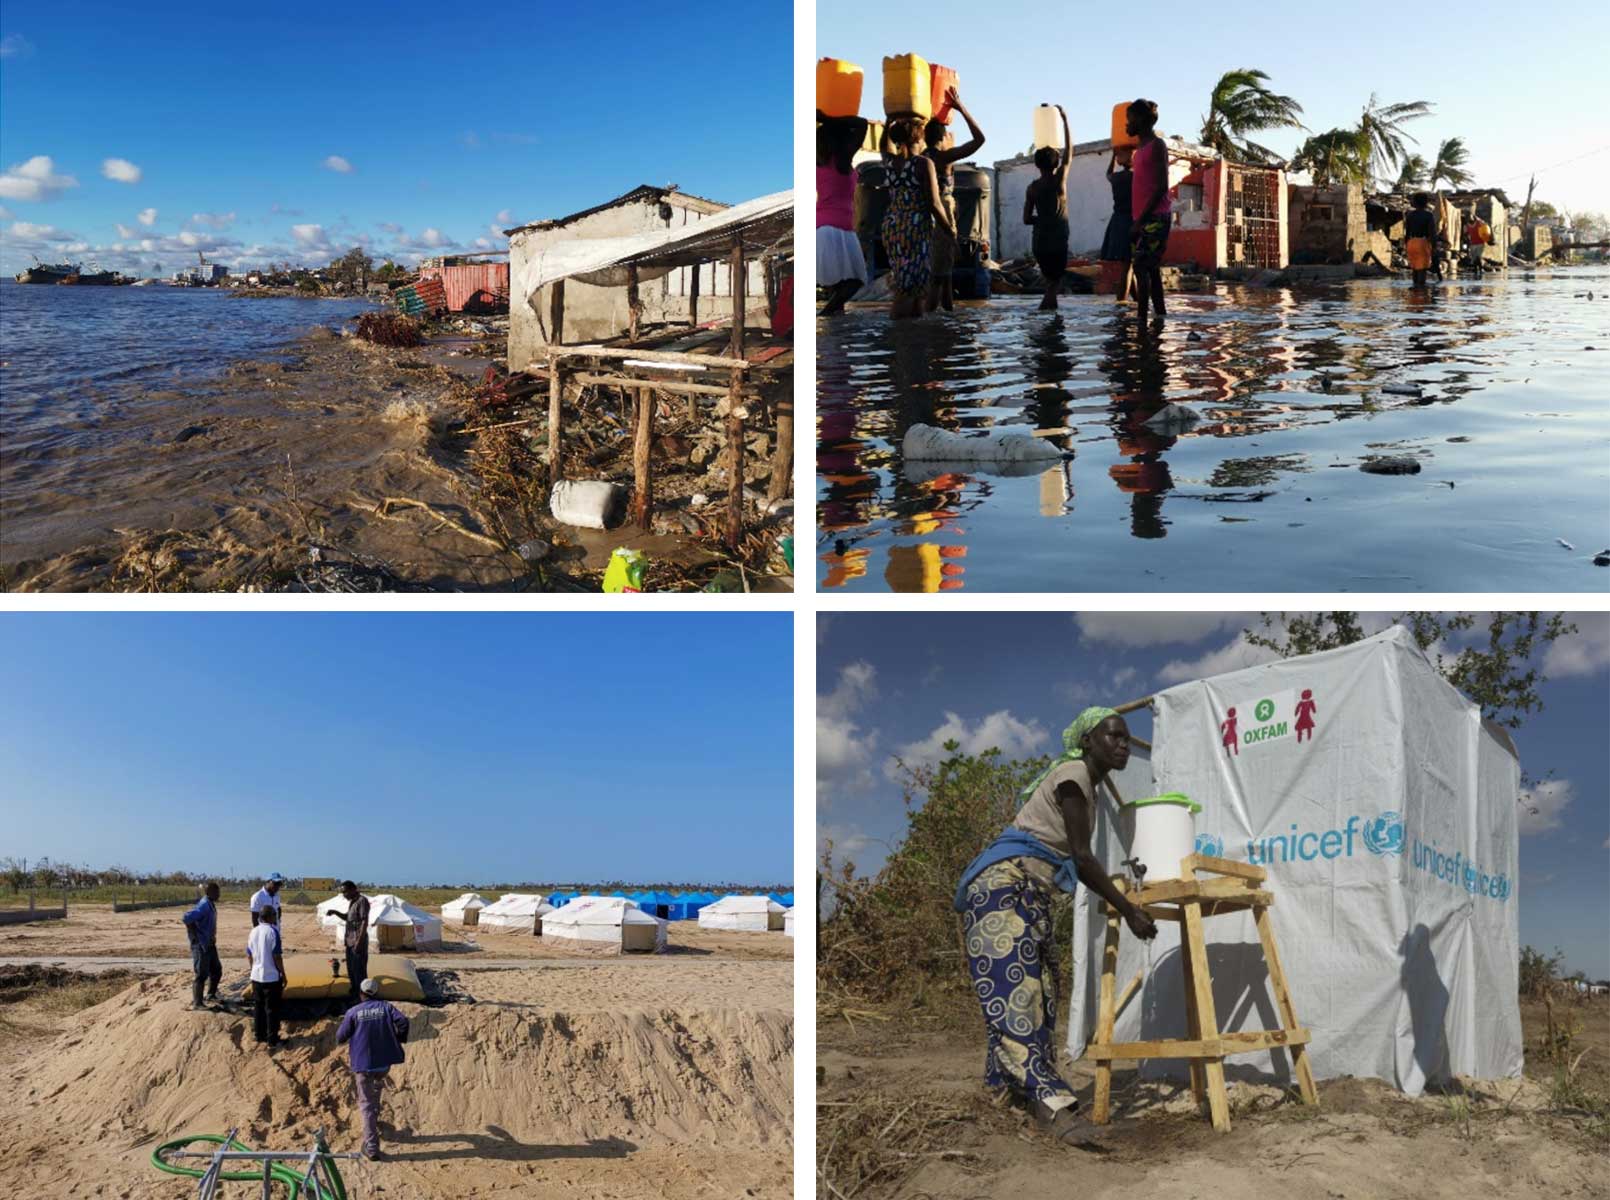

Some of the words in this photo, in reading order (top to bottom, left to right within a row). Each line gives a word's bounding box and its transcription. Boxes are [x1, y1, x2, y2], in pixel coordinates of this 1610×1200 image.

[1243, 721, 1288, 745] OXFAM
[1247, 815, 1360, 865] unicef
[1413, 838, 1462, 886] unicef
